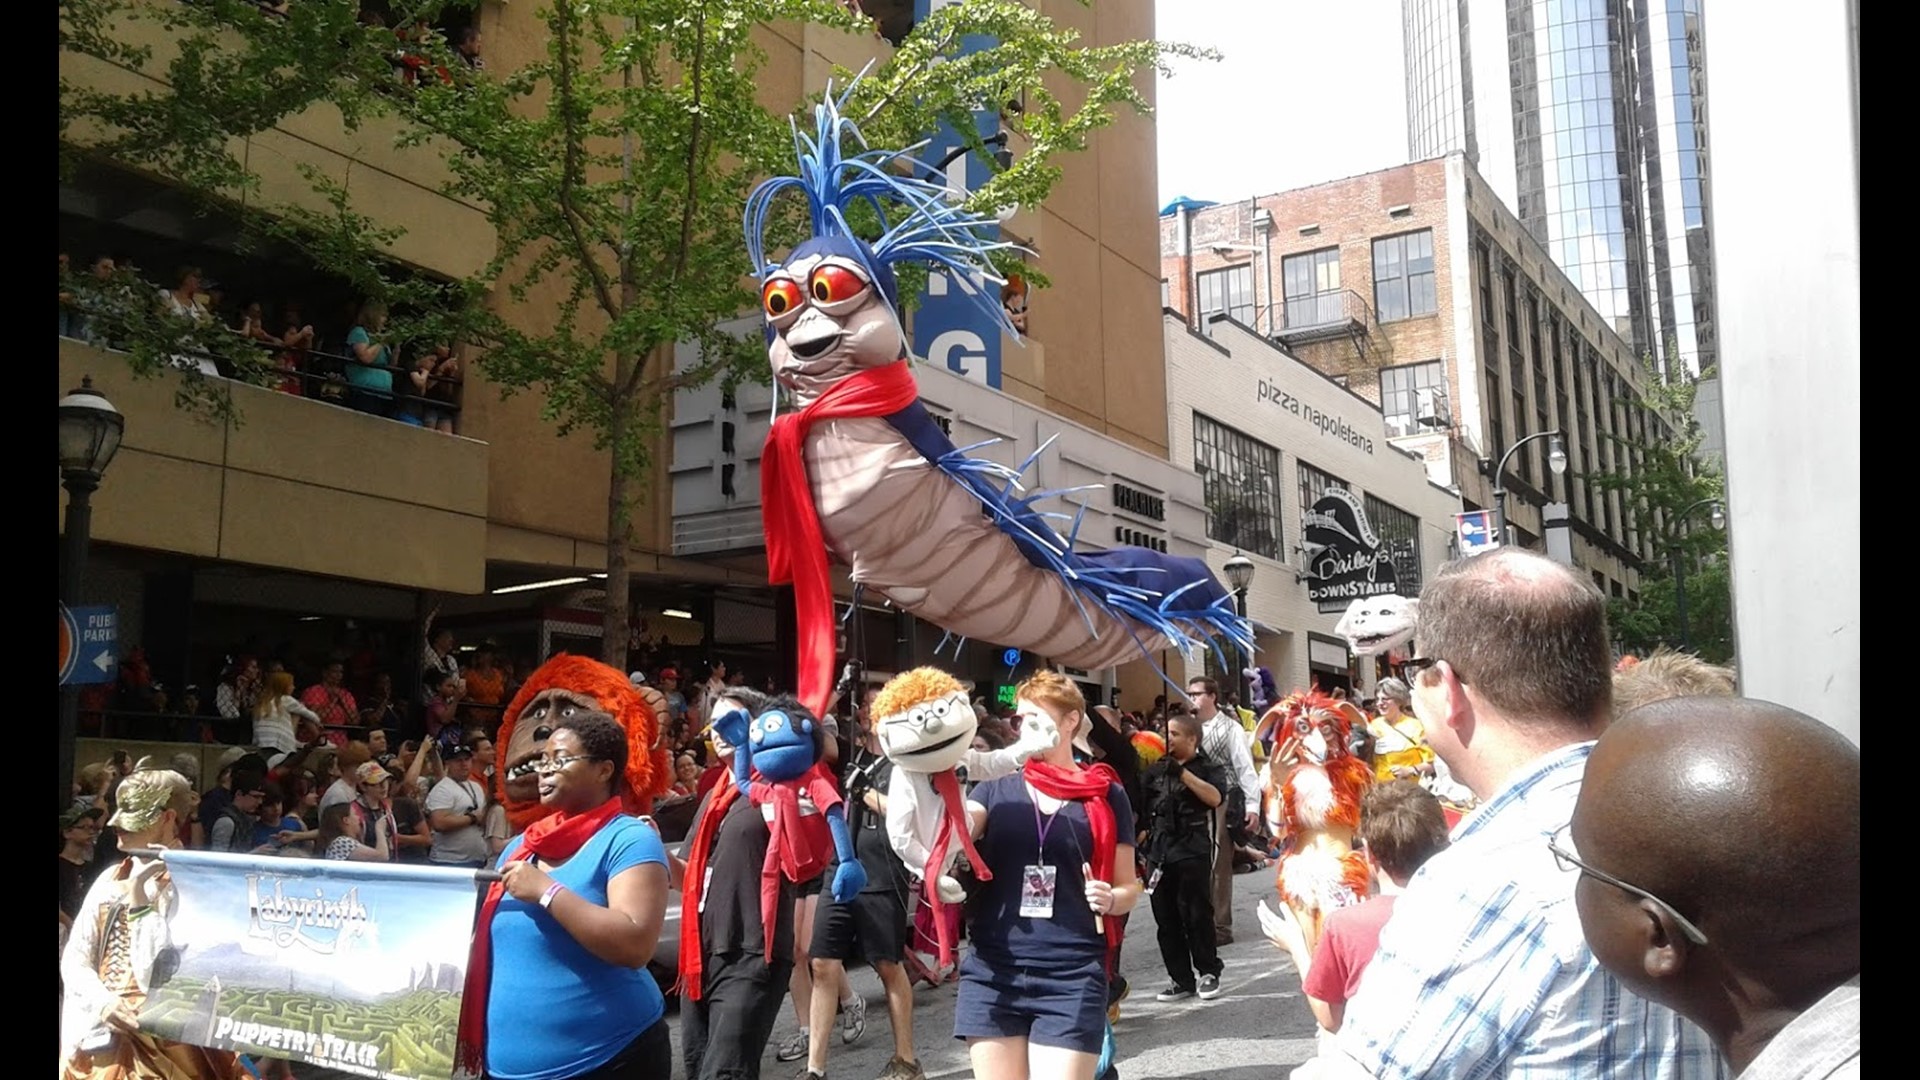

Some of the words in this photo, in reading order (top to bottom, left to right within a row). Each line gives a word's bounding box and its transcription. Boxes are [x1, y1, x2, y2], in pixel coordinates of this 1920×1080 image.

[1257, 377, 1299, 416] pizza
[1303, 403, 1374, 456] napoletana
[1309, 580, 1397, 599] DOWNSTAIRS
[245, 873, 369, 955] Labyrinth
[215, 1017, 318, 1052] PUPPETRY
[321, 1032, 380, 1067] TRACK
